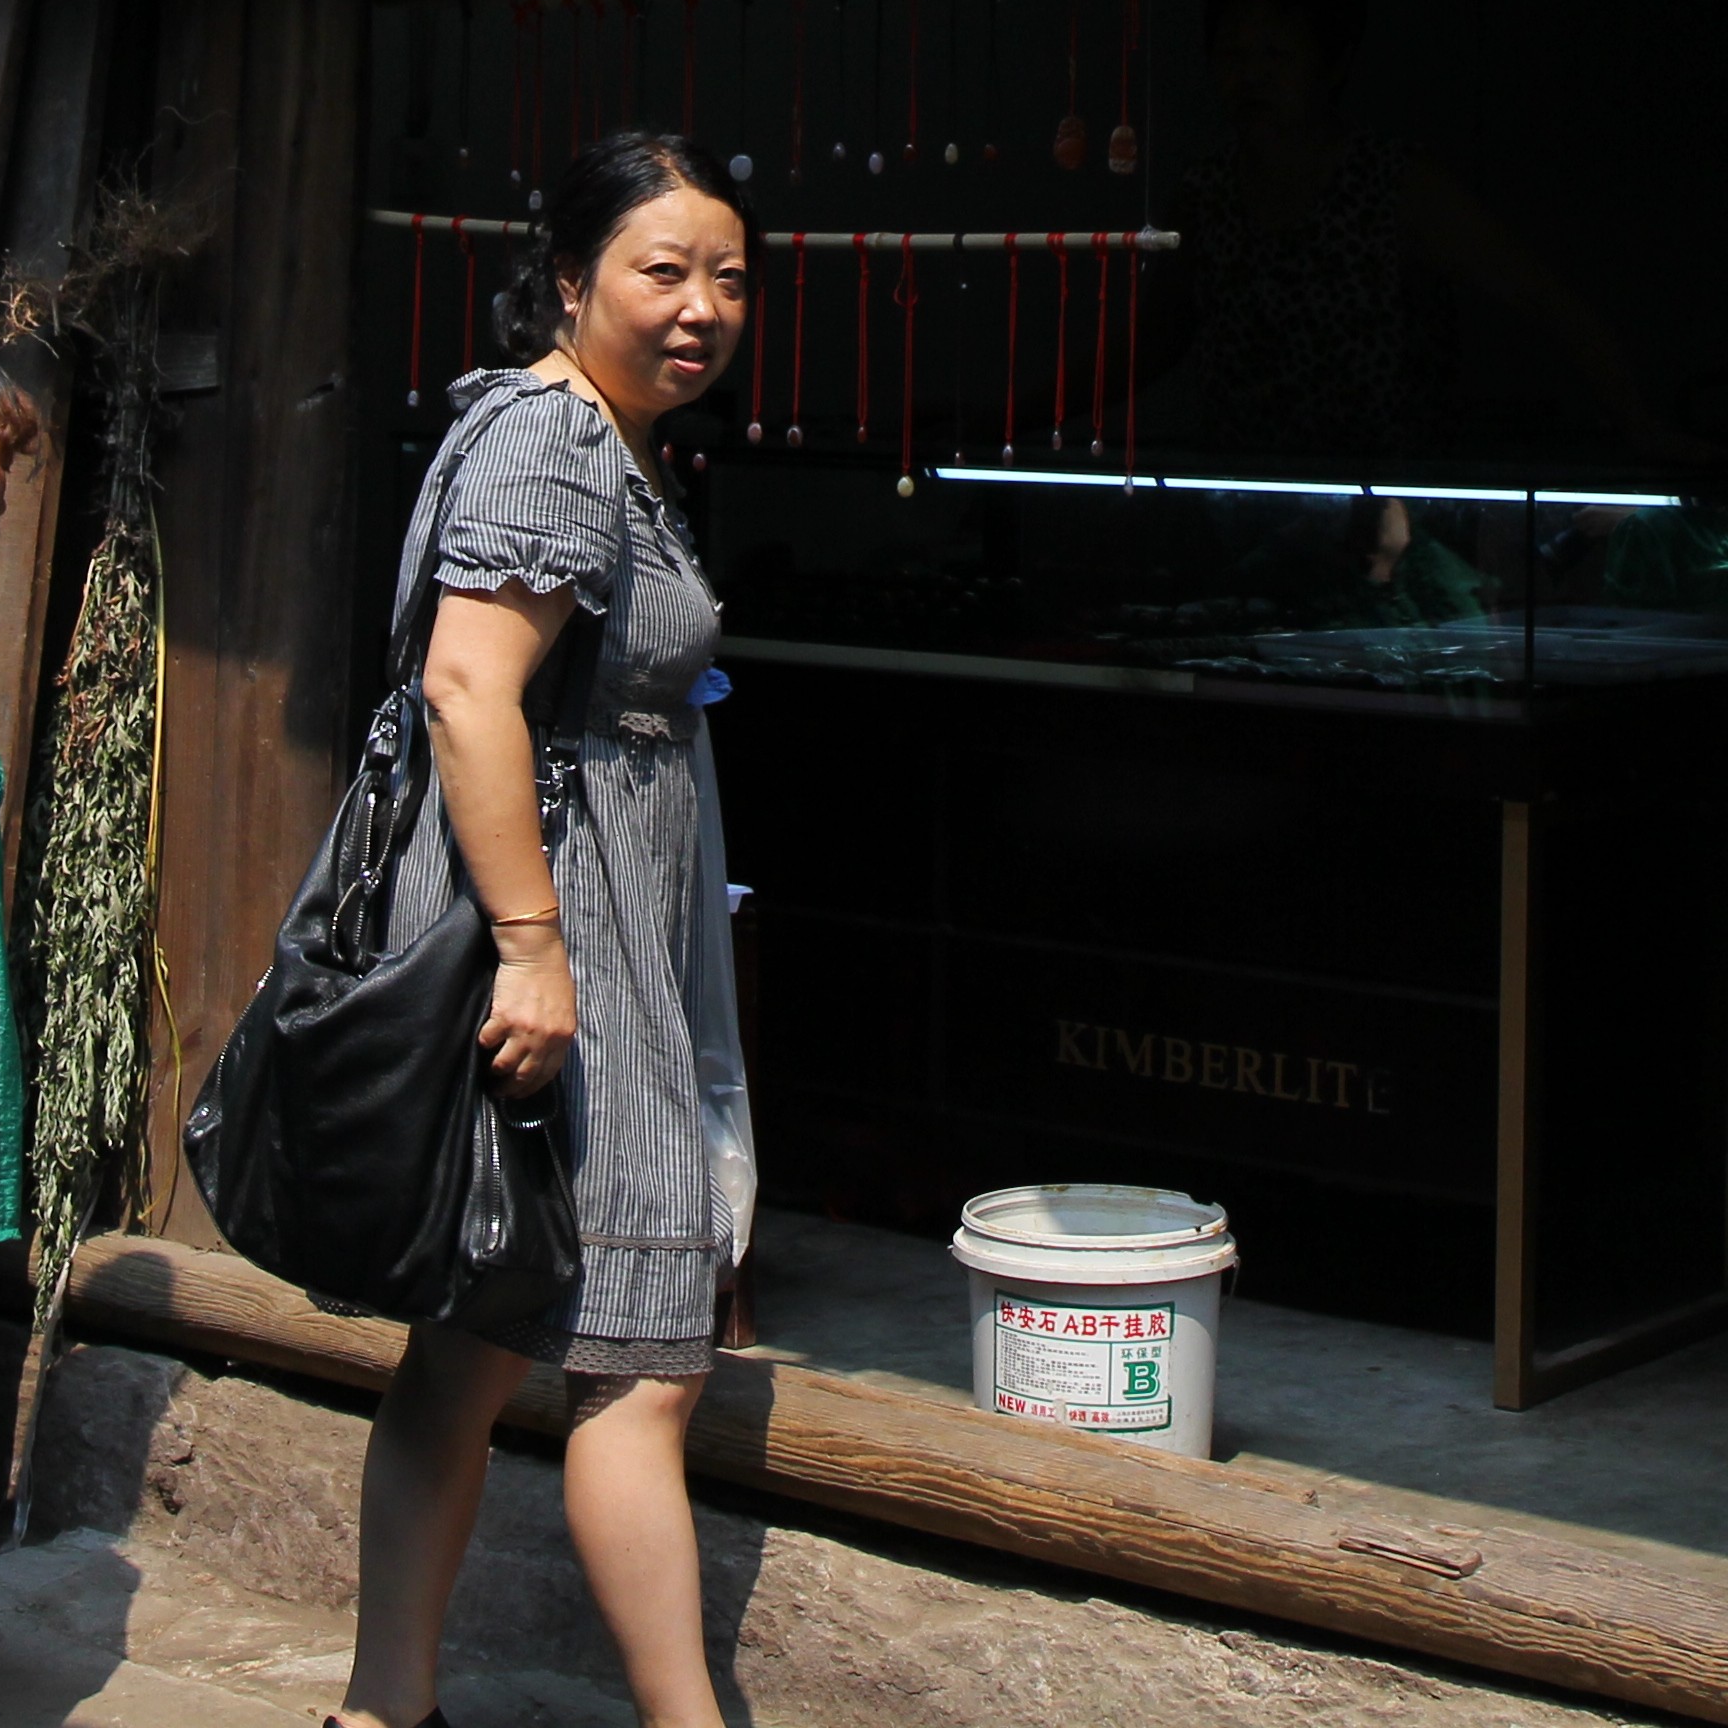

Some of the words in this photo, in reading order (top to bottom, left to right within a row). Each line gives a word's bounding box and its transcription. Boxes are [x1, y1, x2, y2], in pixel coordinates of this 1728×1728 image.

[1055, 1018, 1390, 1115] KIMBERLITE
[1120, 1346, 1162, 1360] 环保型
[1122, 1360, 1161, 1401] B
[998, 1392, 1027, 1414] NEW
